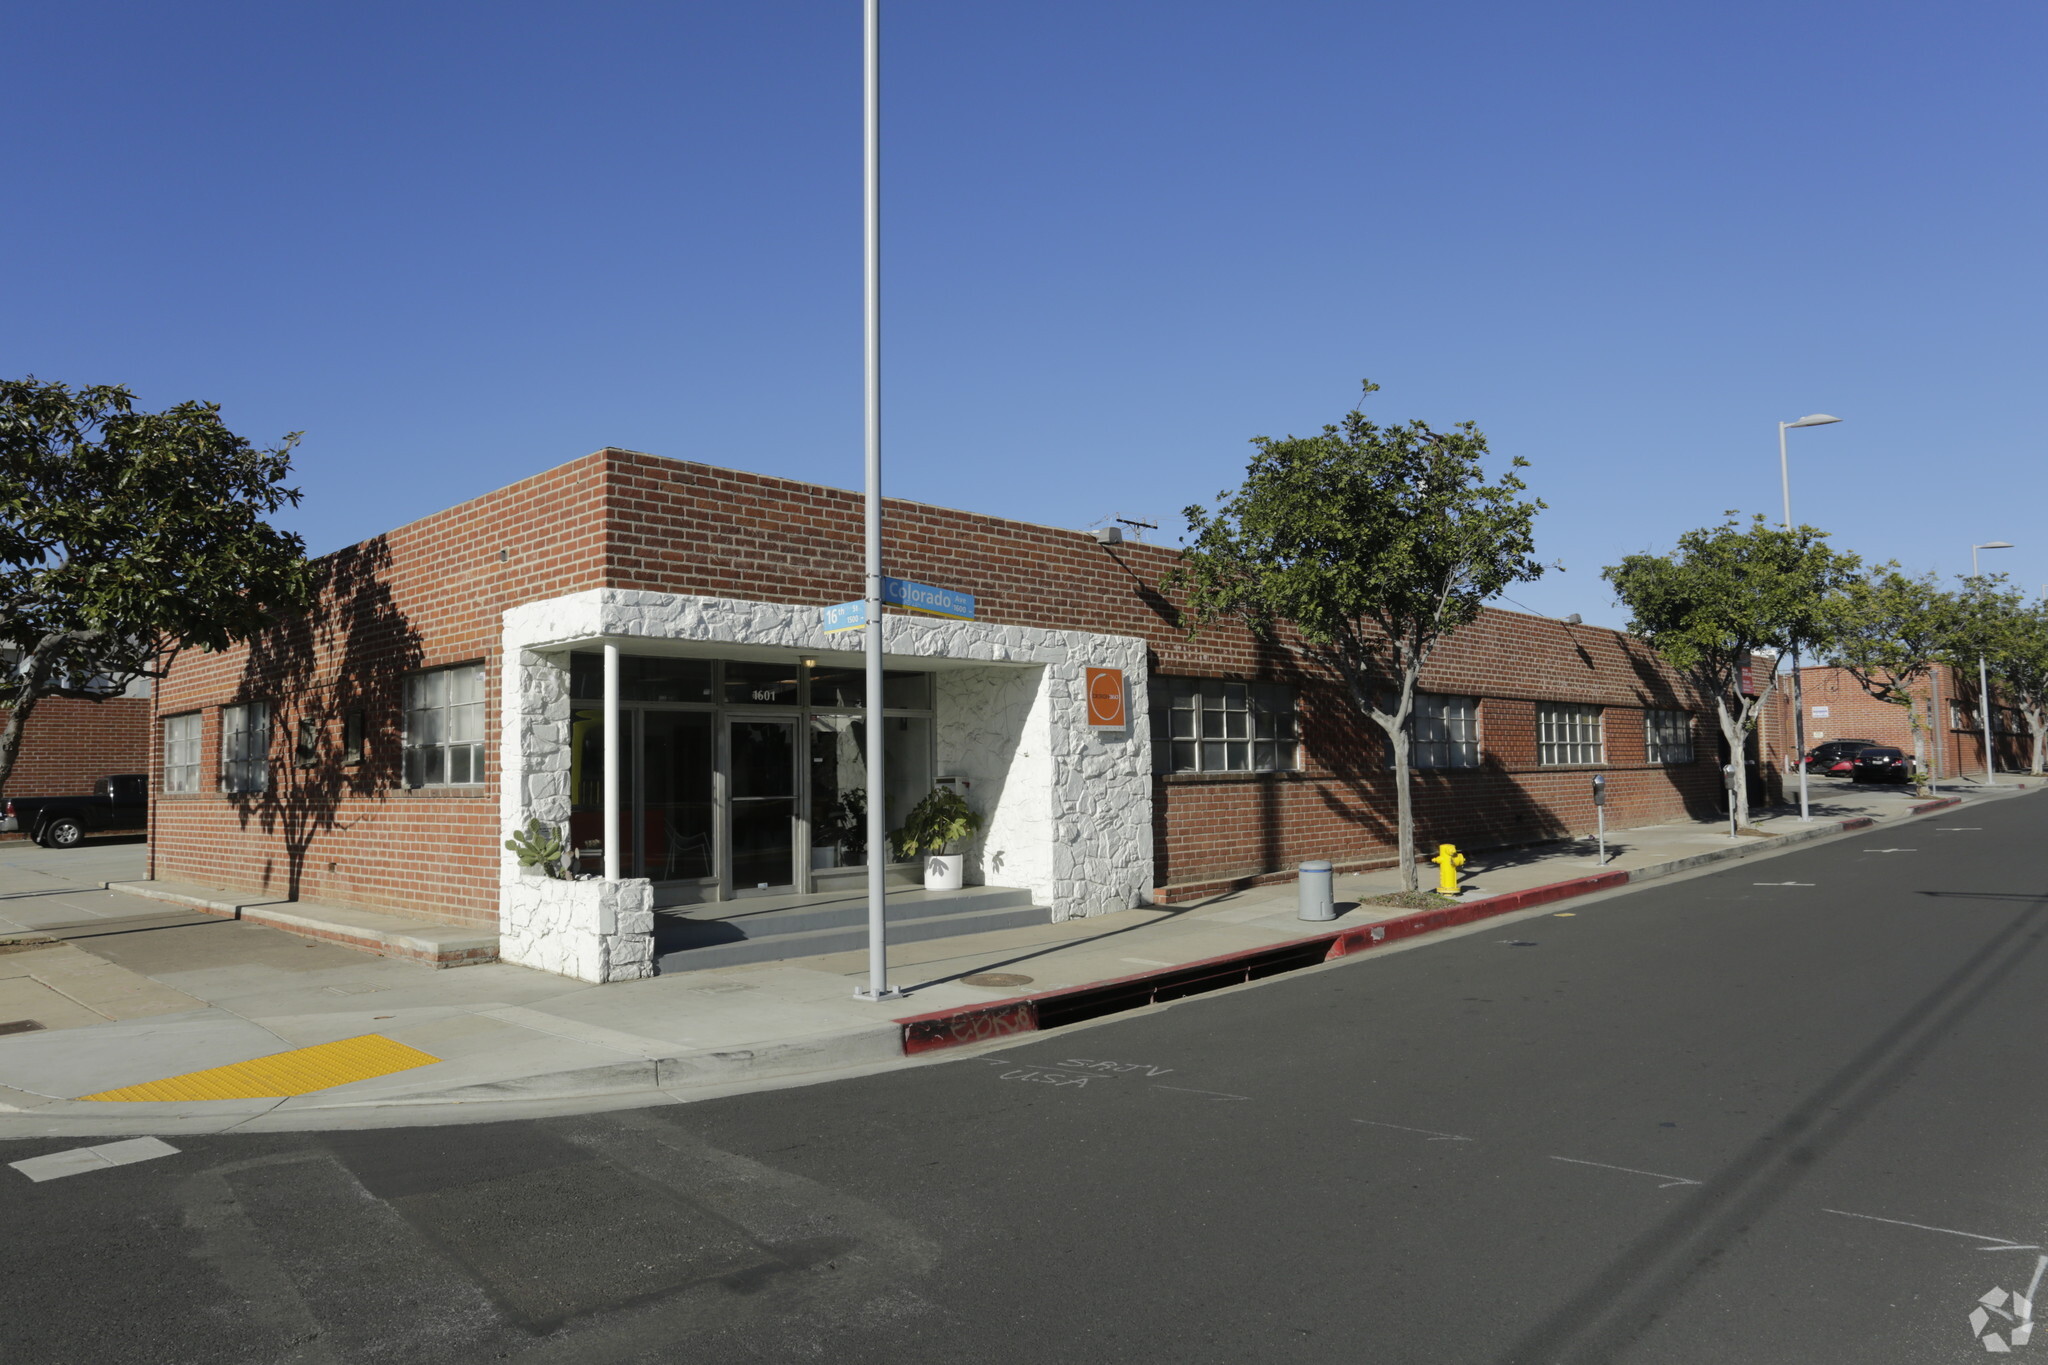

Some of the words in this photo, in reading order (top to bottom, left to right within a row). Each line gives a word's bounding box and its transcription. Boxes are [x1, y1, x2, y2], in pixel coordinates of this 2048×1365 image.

[889, 581, 951, 608] Colorado
[954, 595, 968, 605] Ave
[826, 607, 845, 625] 16th
[752, 690, 776, 702] 1601
